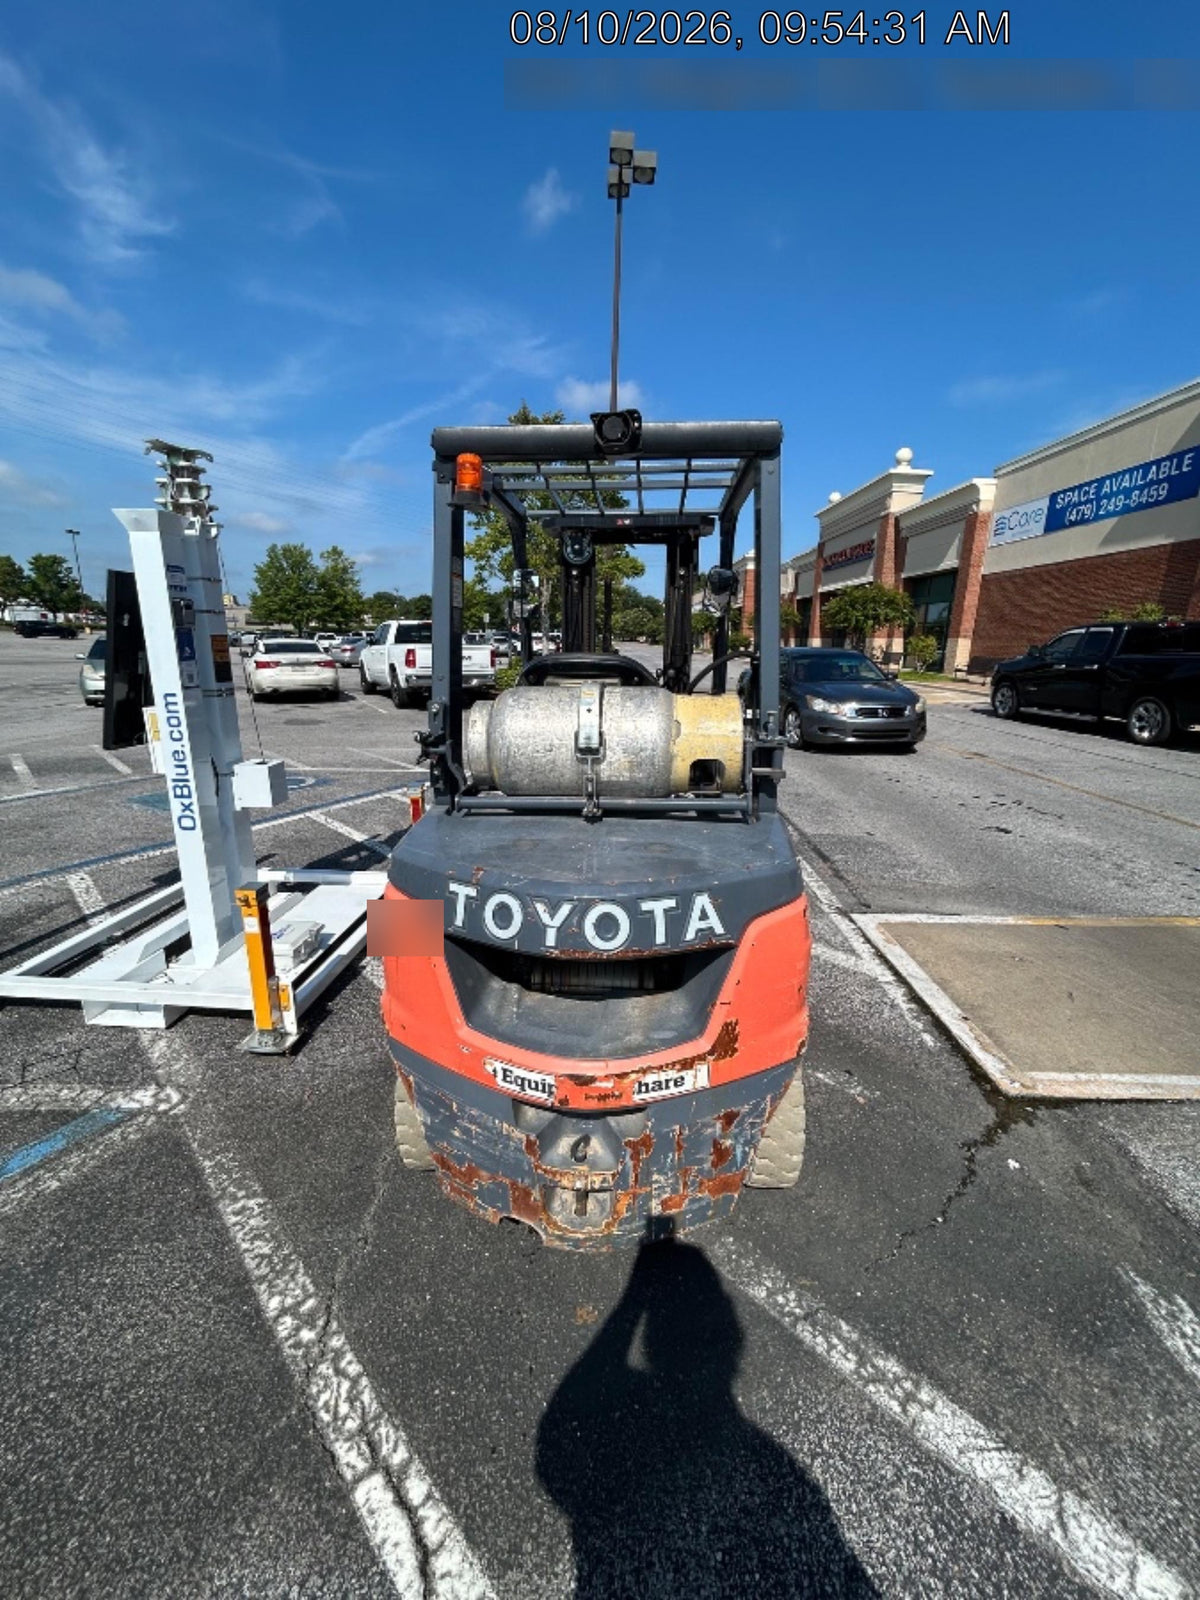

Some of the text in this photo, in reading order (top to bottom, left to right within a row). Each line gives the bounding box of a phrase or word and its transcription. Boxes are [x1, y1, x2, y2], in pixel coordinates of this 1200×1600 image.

[1055, 453, 1195, 509] SPACE AVAILABLE
[1064, 484, 1168, 525] (479) 249-8459
[163, 693, 196, 831] OxBlue.com
[449, 883, 725, 950] TOYOTA
